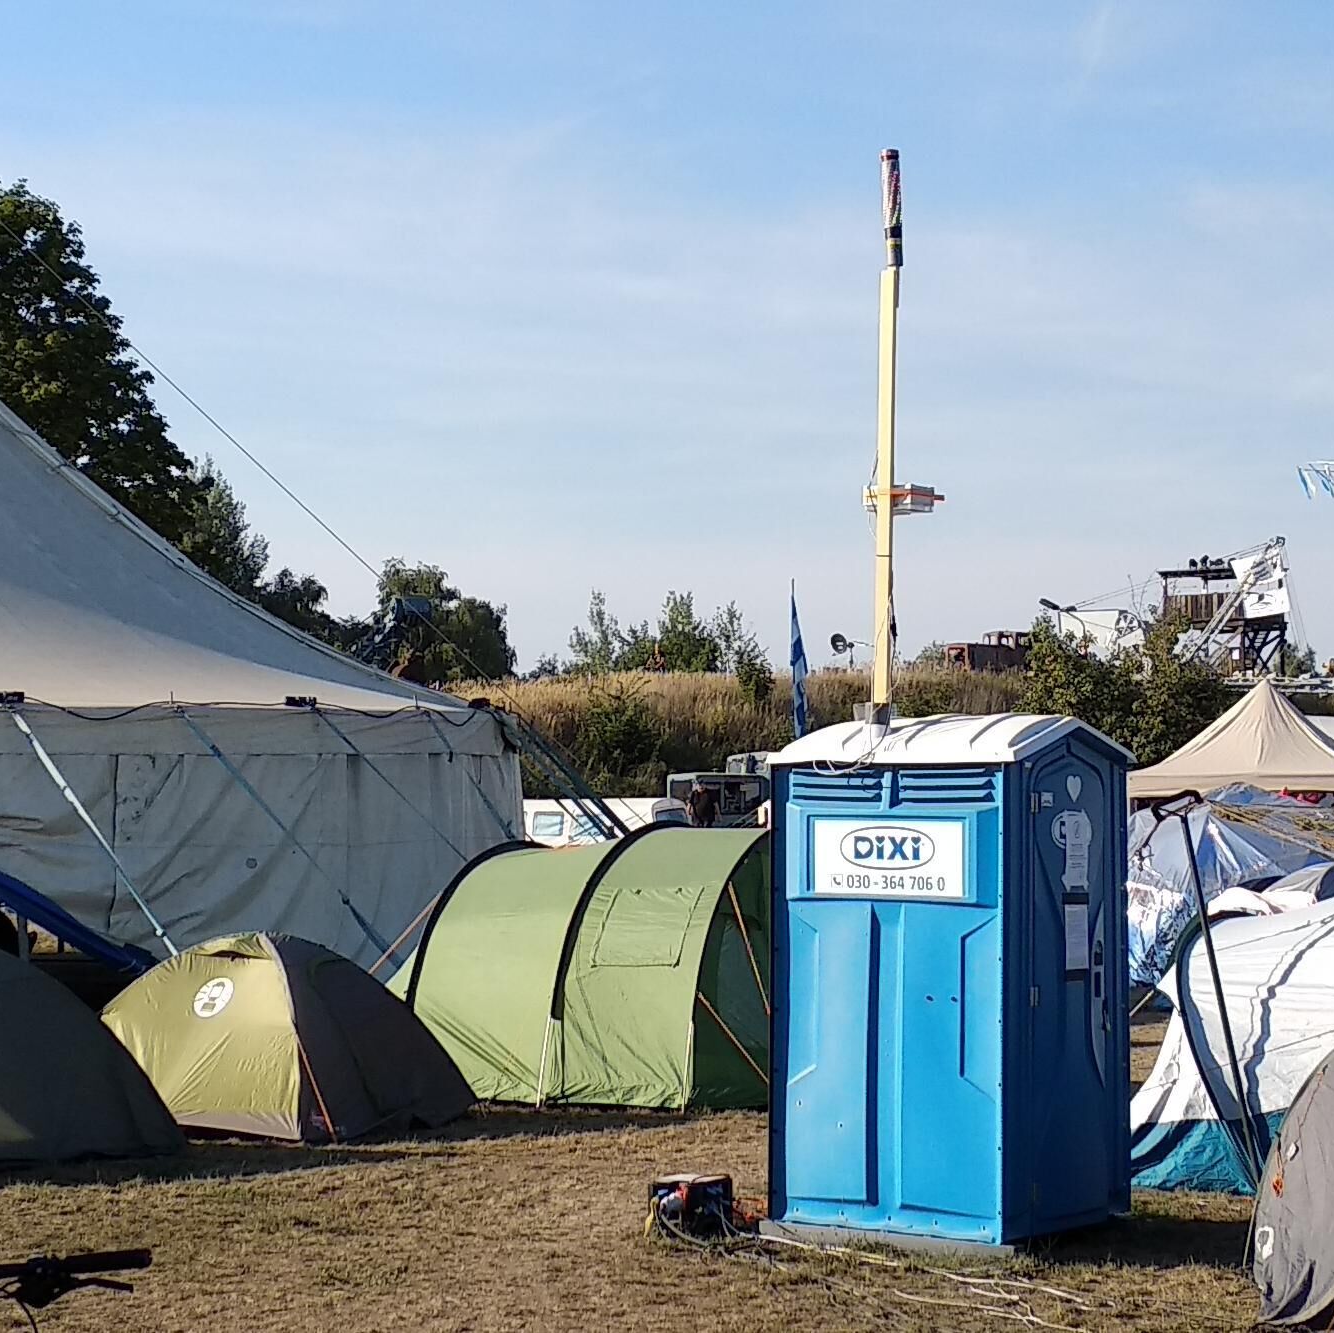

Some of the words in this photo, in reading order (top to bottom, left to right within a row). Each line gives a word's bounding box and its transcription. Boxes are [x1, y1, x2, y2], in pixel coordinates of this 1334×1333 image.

[846, 874, 871, 889] 030
[881, 875, 905, 890] 364
[909, 876, 934, 891] 706
[937, 876, 946, 891] 0
